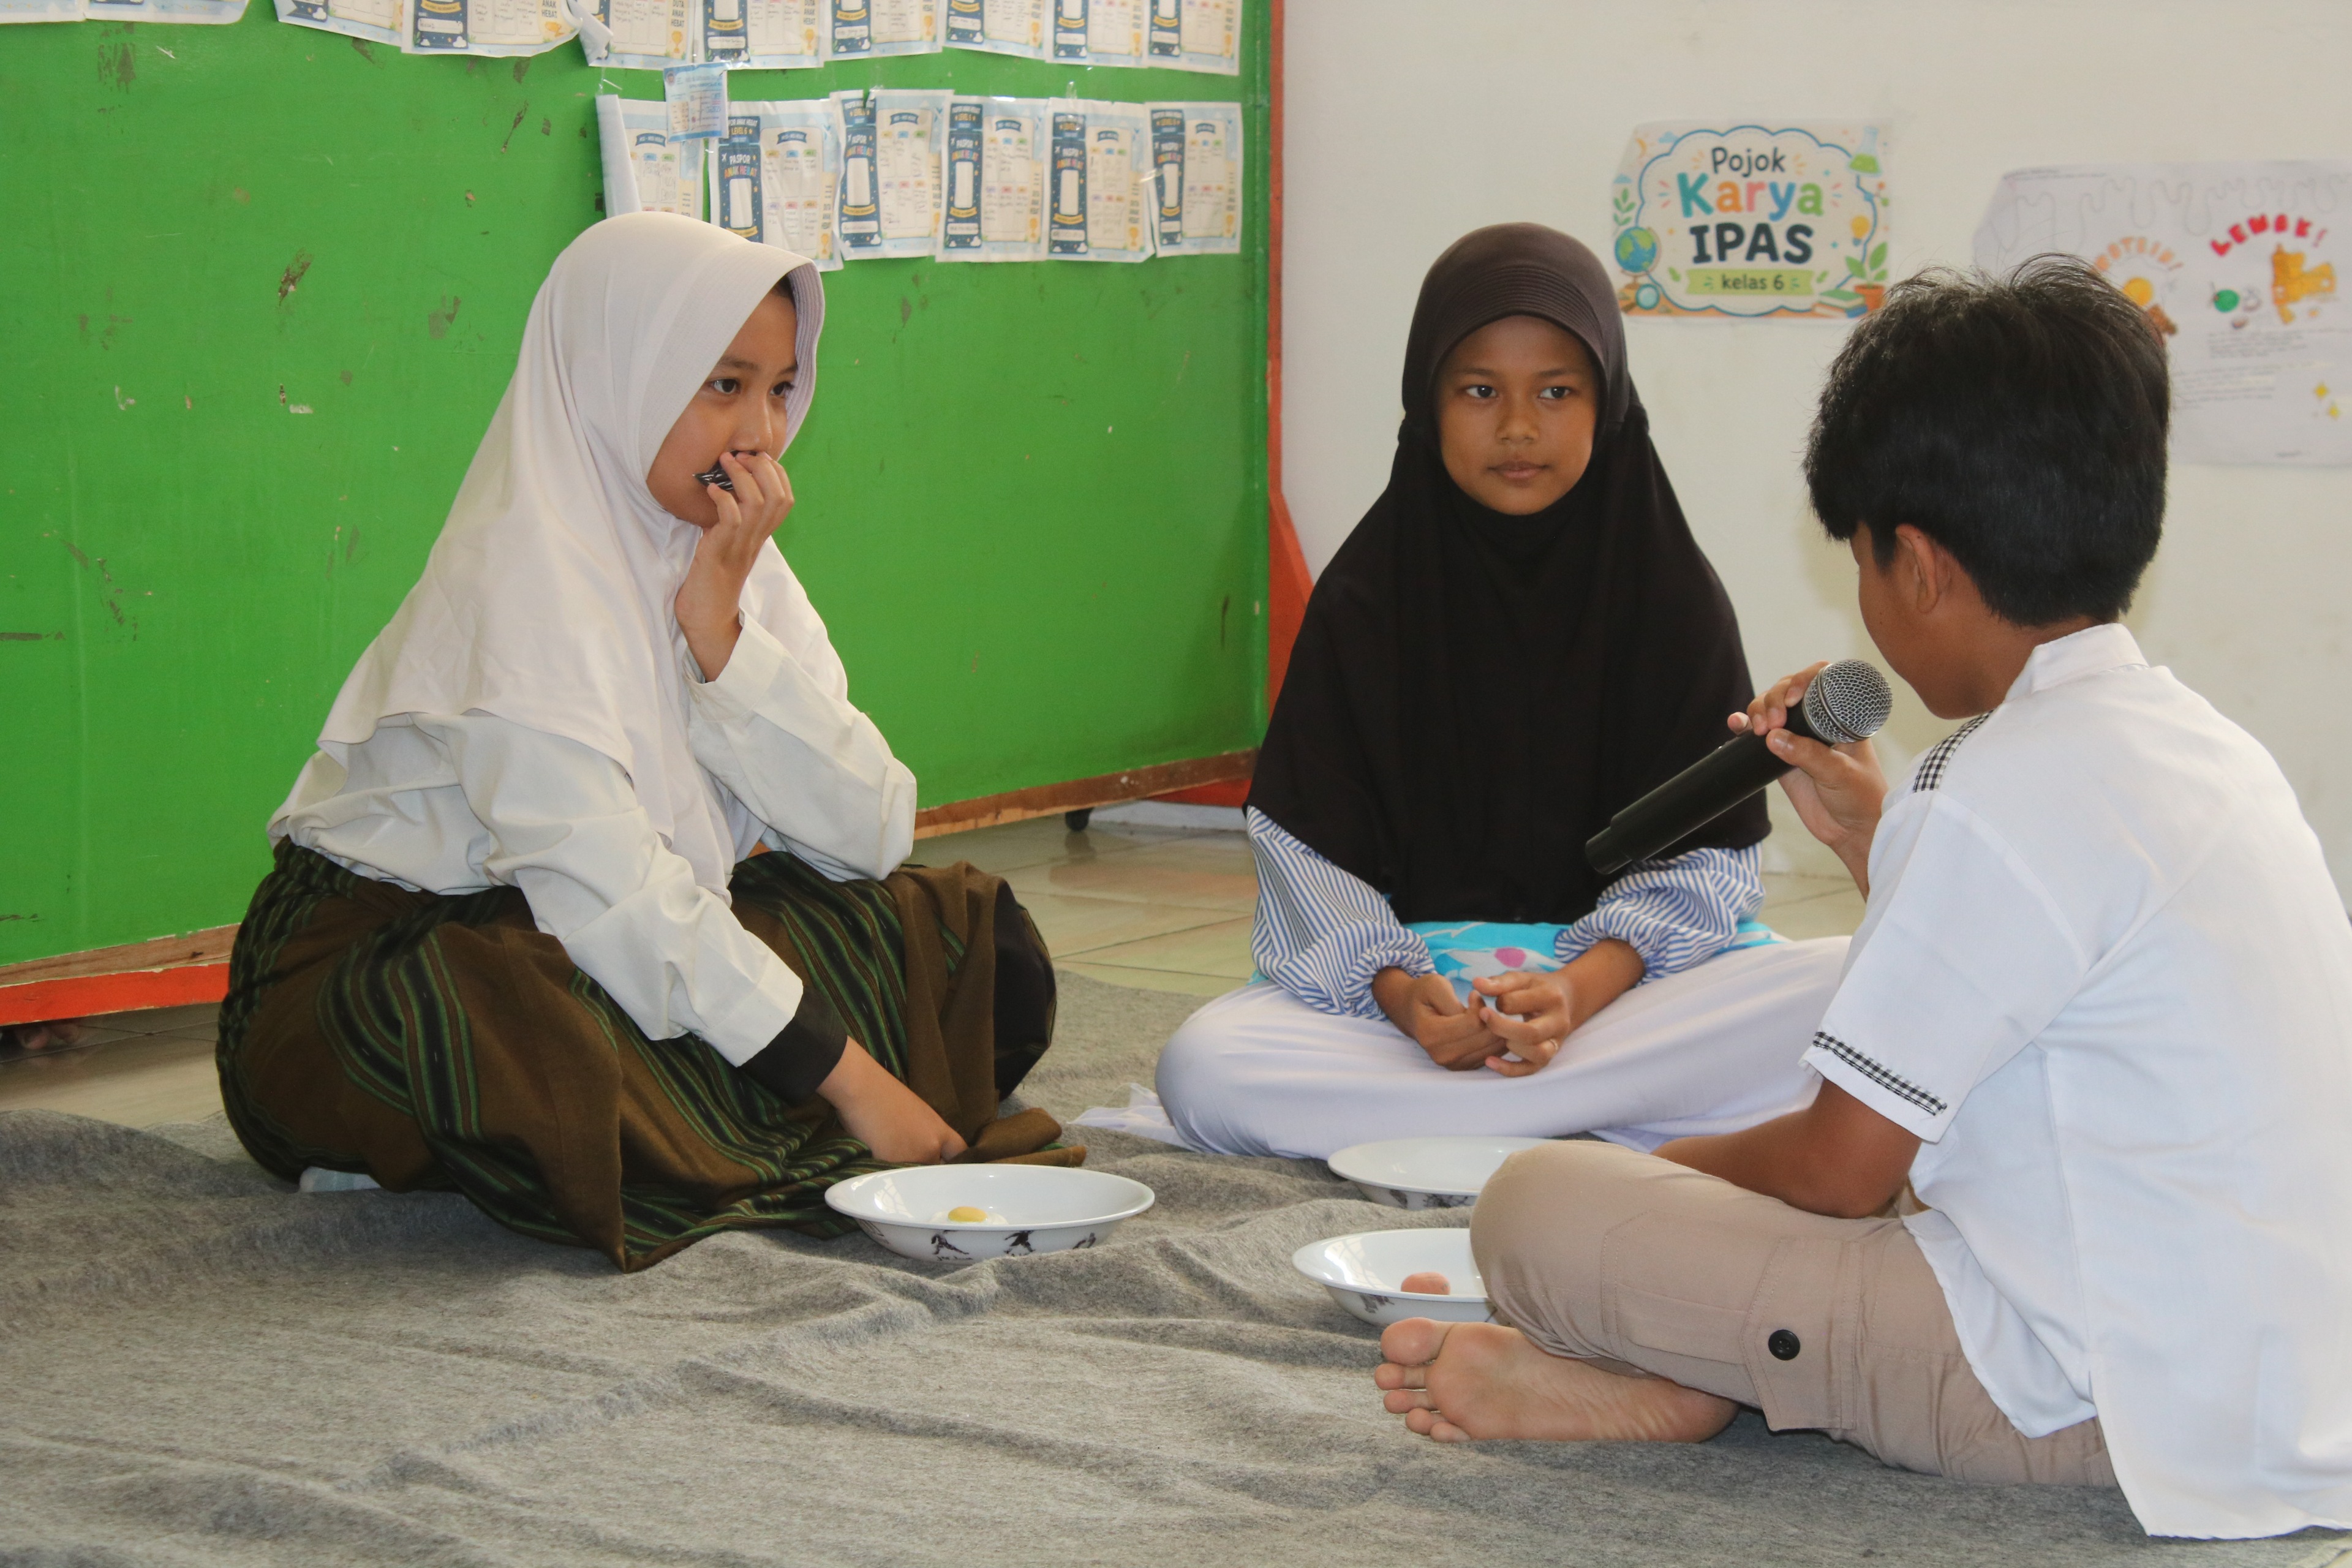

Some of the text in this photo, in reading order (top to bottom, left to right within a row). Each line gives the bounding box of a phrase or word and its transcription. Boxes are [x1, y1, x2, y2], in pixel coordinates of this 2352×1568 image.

[541, 9, 558, 18] HEBAT
[671, 18, 685, 28] HEBAT
[729, 153, 751, 165] PASPOR
[1711, 146, 1787, 178] Pojok
[1676, 172, 1825, 222] Karya
[1689, 222, 1815, 264] IPAS
[2089, 236, 2185, 274] ROTEIN!
[1721, 274, 1784, 290] kelas 6
